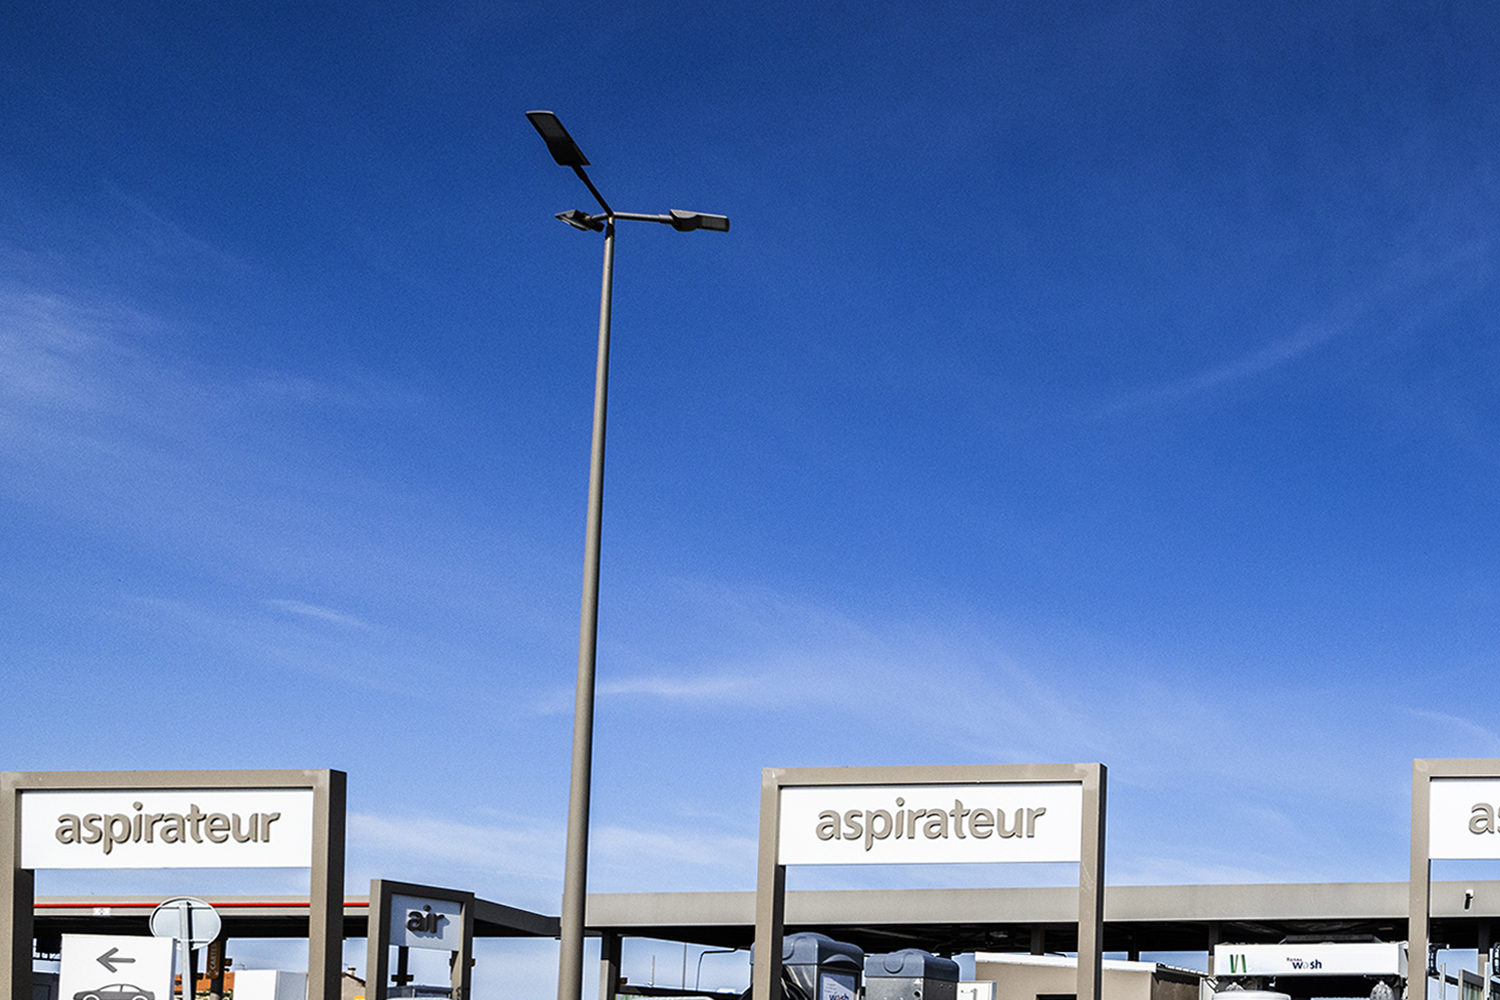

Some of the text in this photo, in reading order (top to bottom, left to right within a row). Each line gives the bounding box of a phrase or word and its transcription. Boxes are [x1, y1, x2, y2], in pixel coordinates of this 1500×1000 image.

[55, 801, 281, 855] aspirateur
[816, 797, 1047, 851] aspirateur
[407, 904, 445, 934] air
[1292, 959, 1323, 970] wash
